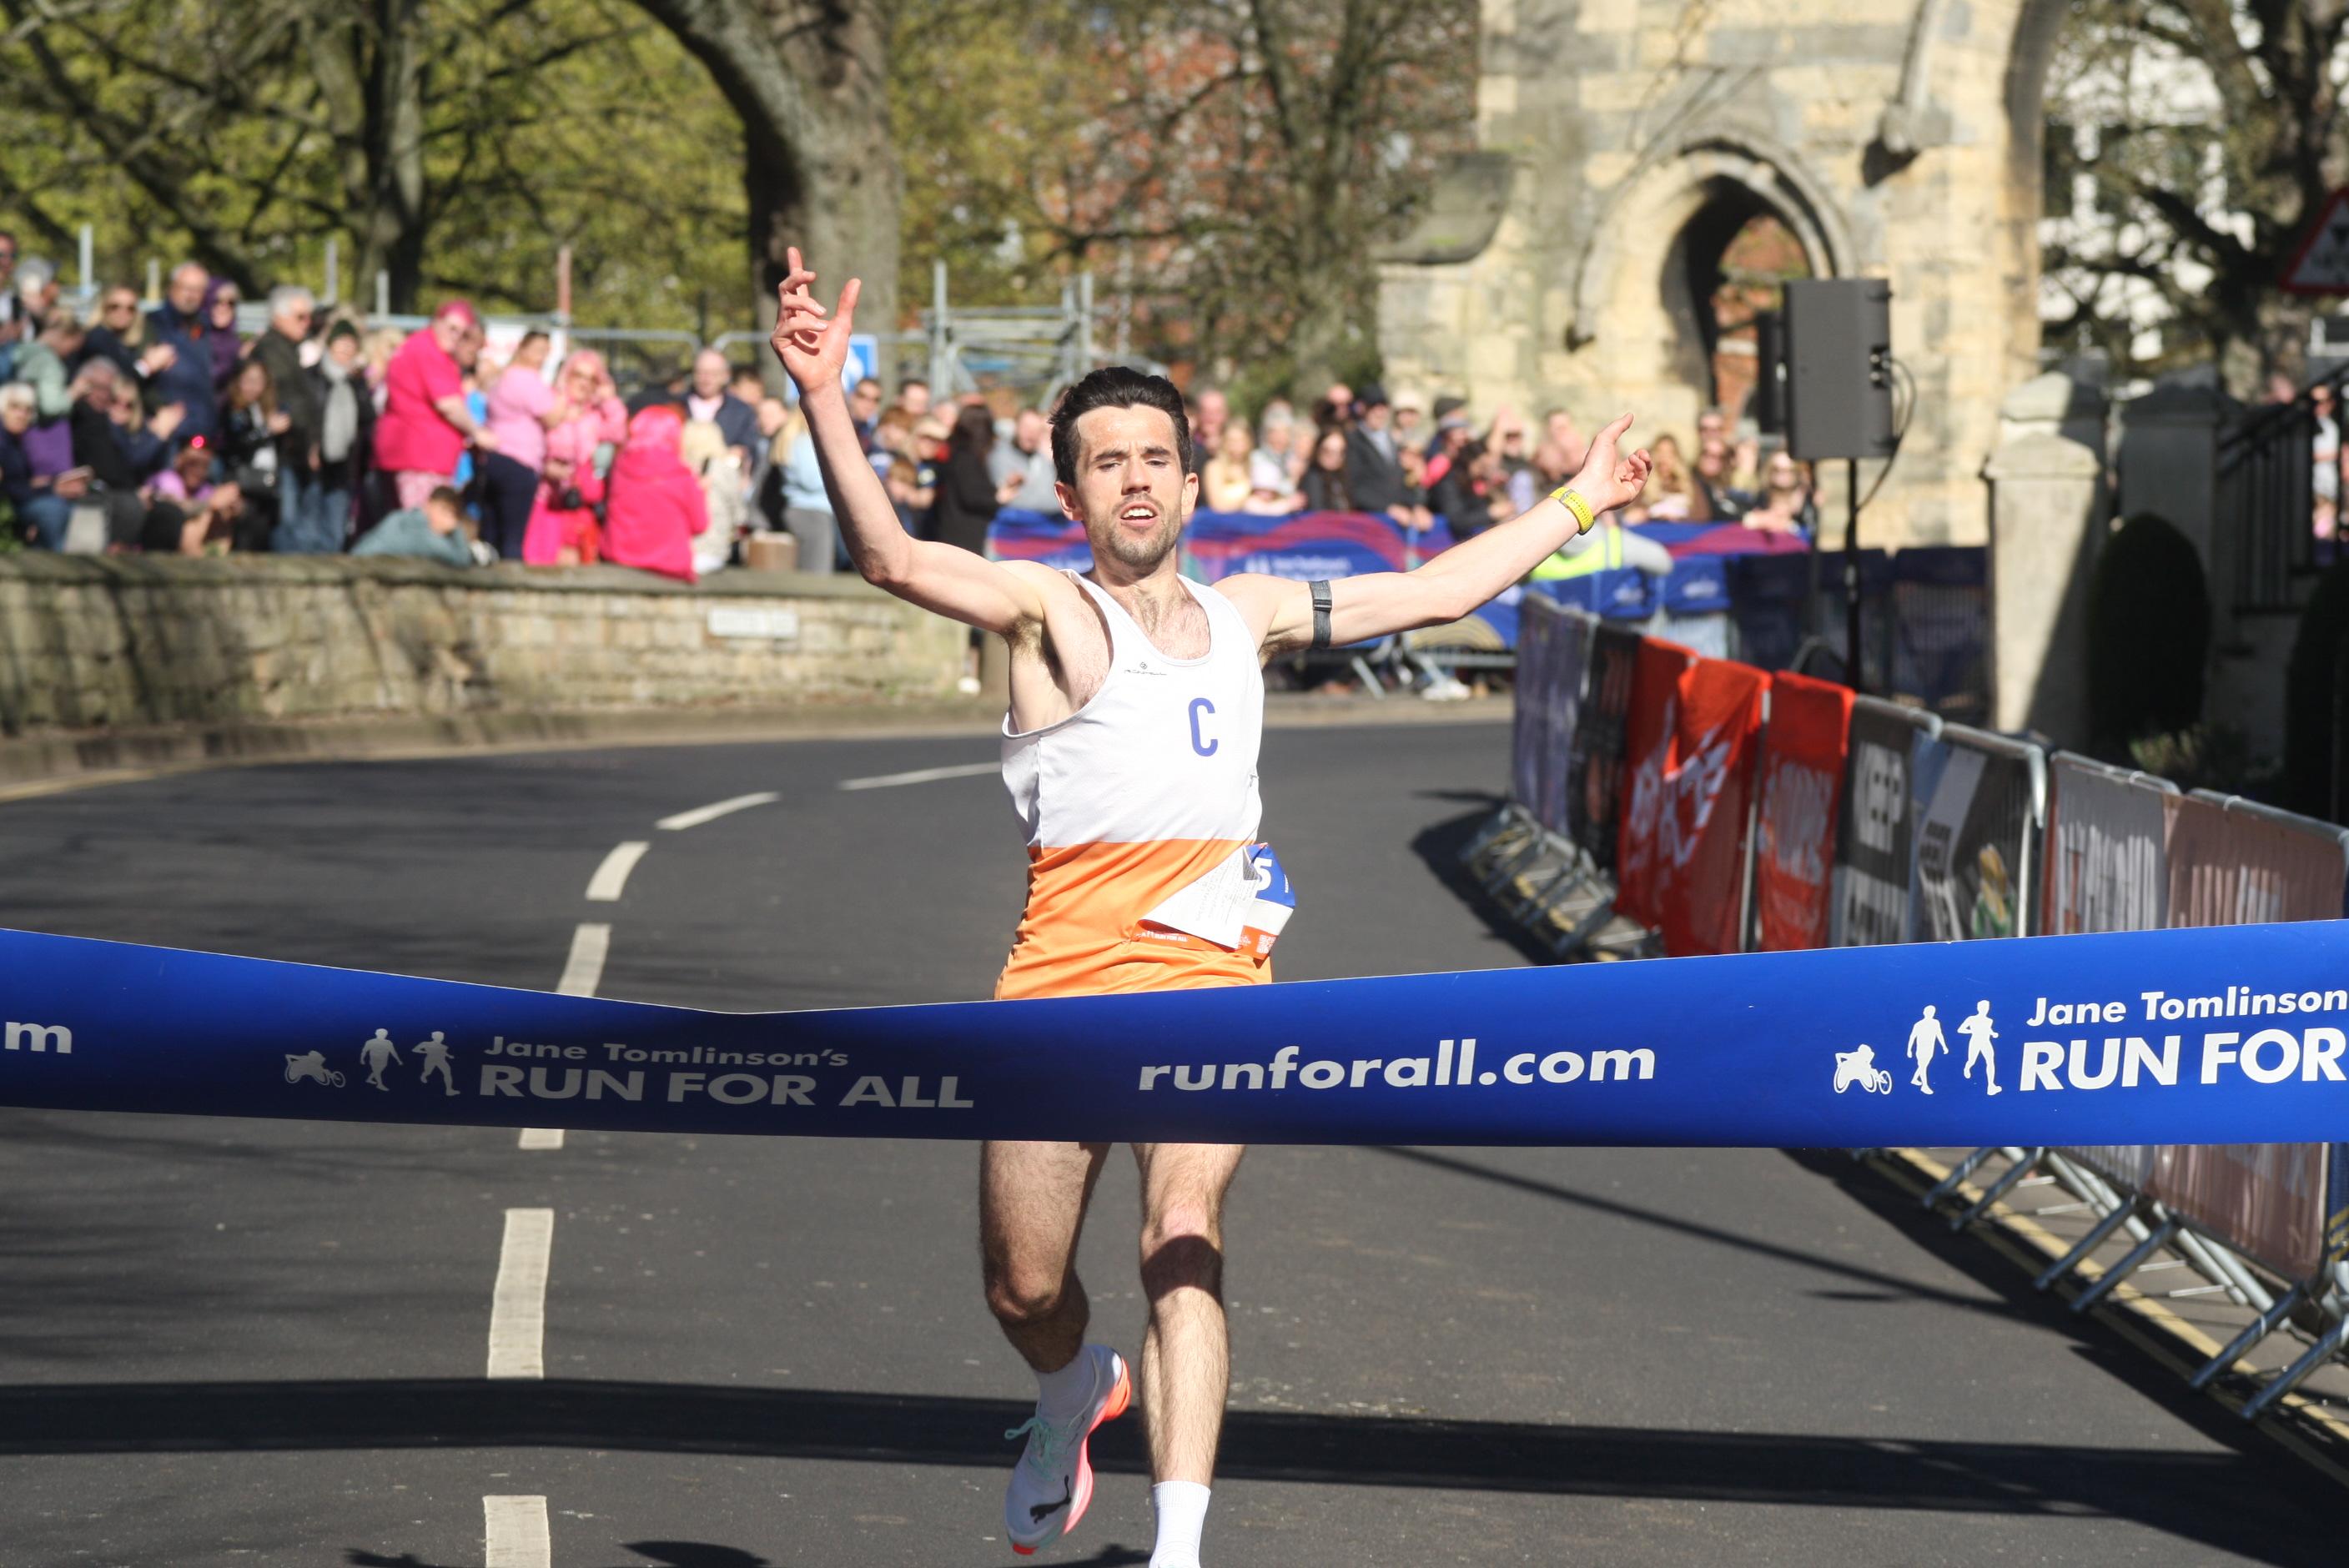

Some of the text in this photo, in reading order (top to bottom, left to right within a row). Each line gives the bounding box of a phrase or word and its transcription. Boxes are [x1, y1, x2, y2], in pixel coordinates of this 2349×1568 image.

[1188, 697, 1218, 756] C
[2026, 997, 2127, 1027] Jane
[485, 1036, 848, 1067] Jane Tomlinson's
[1139, 1038, 1656, 1091] runforall.com
[2020, 1027, 2347, 1092] RUN FOR
[480, 1064, 974, 1108] RUN FOR ALL
